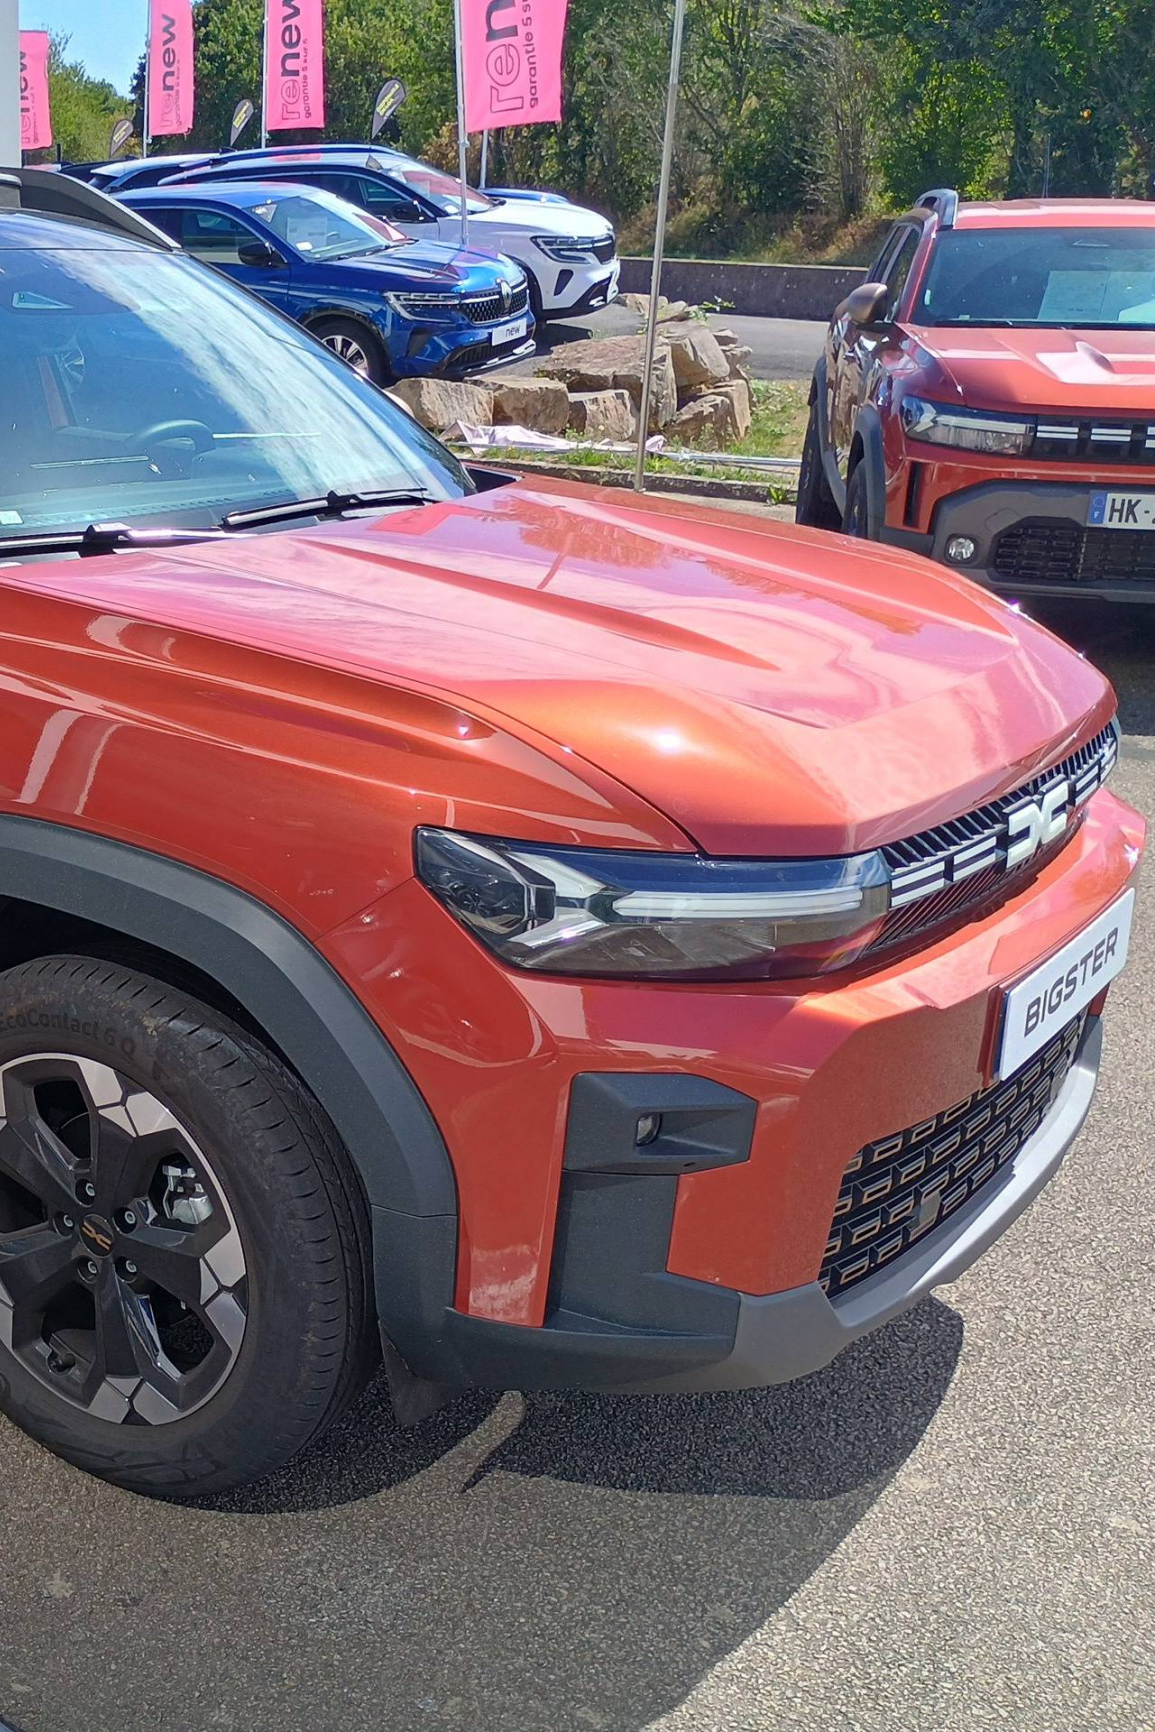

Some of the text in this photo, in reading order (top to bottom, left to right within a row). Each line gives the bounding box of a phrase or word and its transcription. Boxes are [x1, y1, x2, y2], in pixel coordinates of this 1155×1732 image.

[522, 32, 539, 109] garantie
[1024, 927, 1118, 1038] BIGSTER
[104, 1027, 116, 1046] 6
